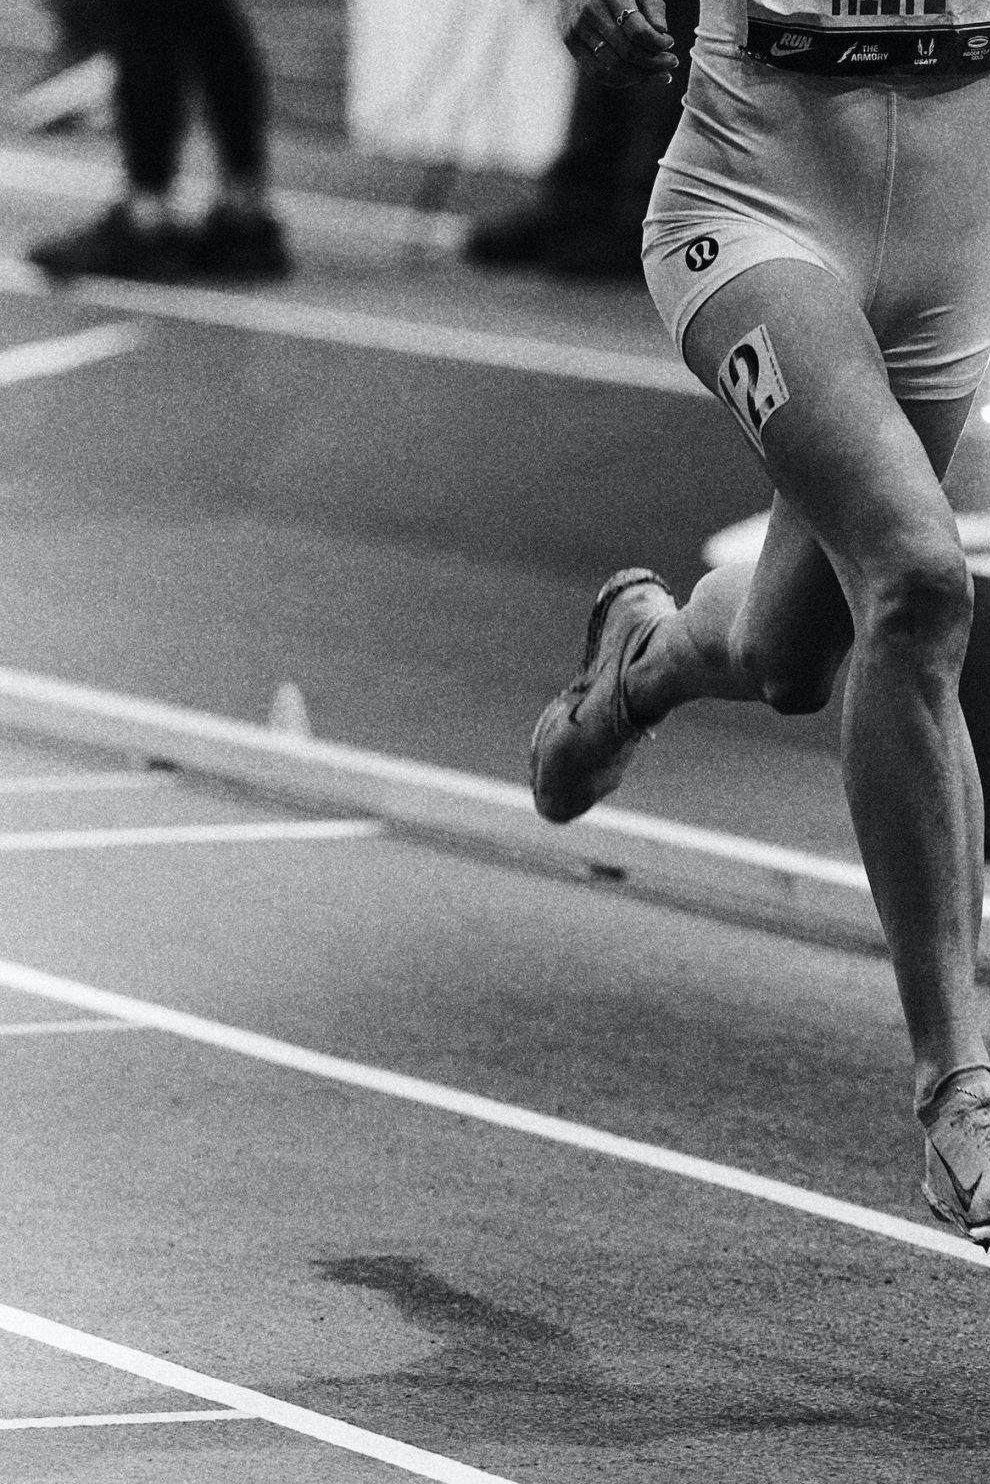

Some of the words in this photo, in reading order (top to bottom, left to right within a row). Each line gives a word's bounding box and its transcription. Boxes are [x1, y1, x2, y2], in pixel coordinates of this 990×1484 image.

[780, 33, 813, 49] RUN
[862, 45, 879, 53] THE
[851, 53, 889, 62] ARMORY
[728, 343, 775, 433] 2
